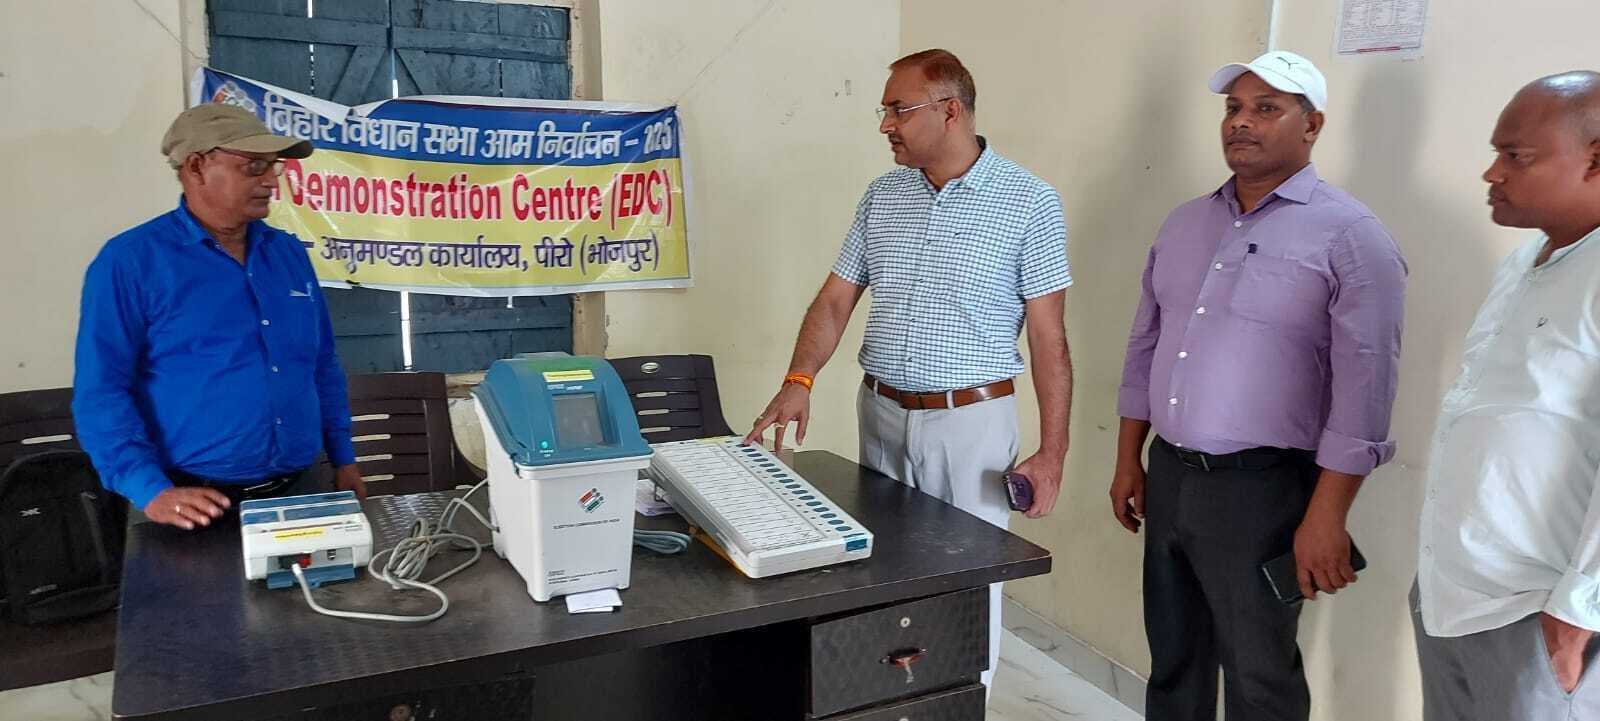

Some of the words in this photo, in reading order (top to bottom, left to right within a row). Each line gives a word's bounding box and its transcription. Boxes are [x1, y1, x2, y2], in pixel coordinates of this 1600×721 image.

[340, 115, 421, 153] विधान
[423, 122, 479, 157] सभा
[480, 129, 535, 159] आम
[535, 120, 622, 160] निर्वाचन
[285, 158, 501, 220] Demonstration
[512, 174, 601, 221] Centre
[611, 169, 672, 230] (EDC)
[320, 236, 425, 274] अनुमण्डल
[429, 235, 528, 272] कार्यालय,
[534, 236, 574, 268] पीरो
[580, 231, 659, 275] (भोजपुर)
